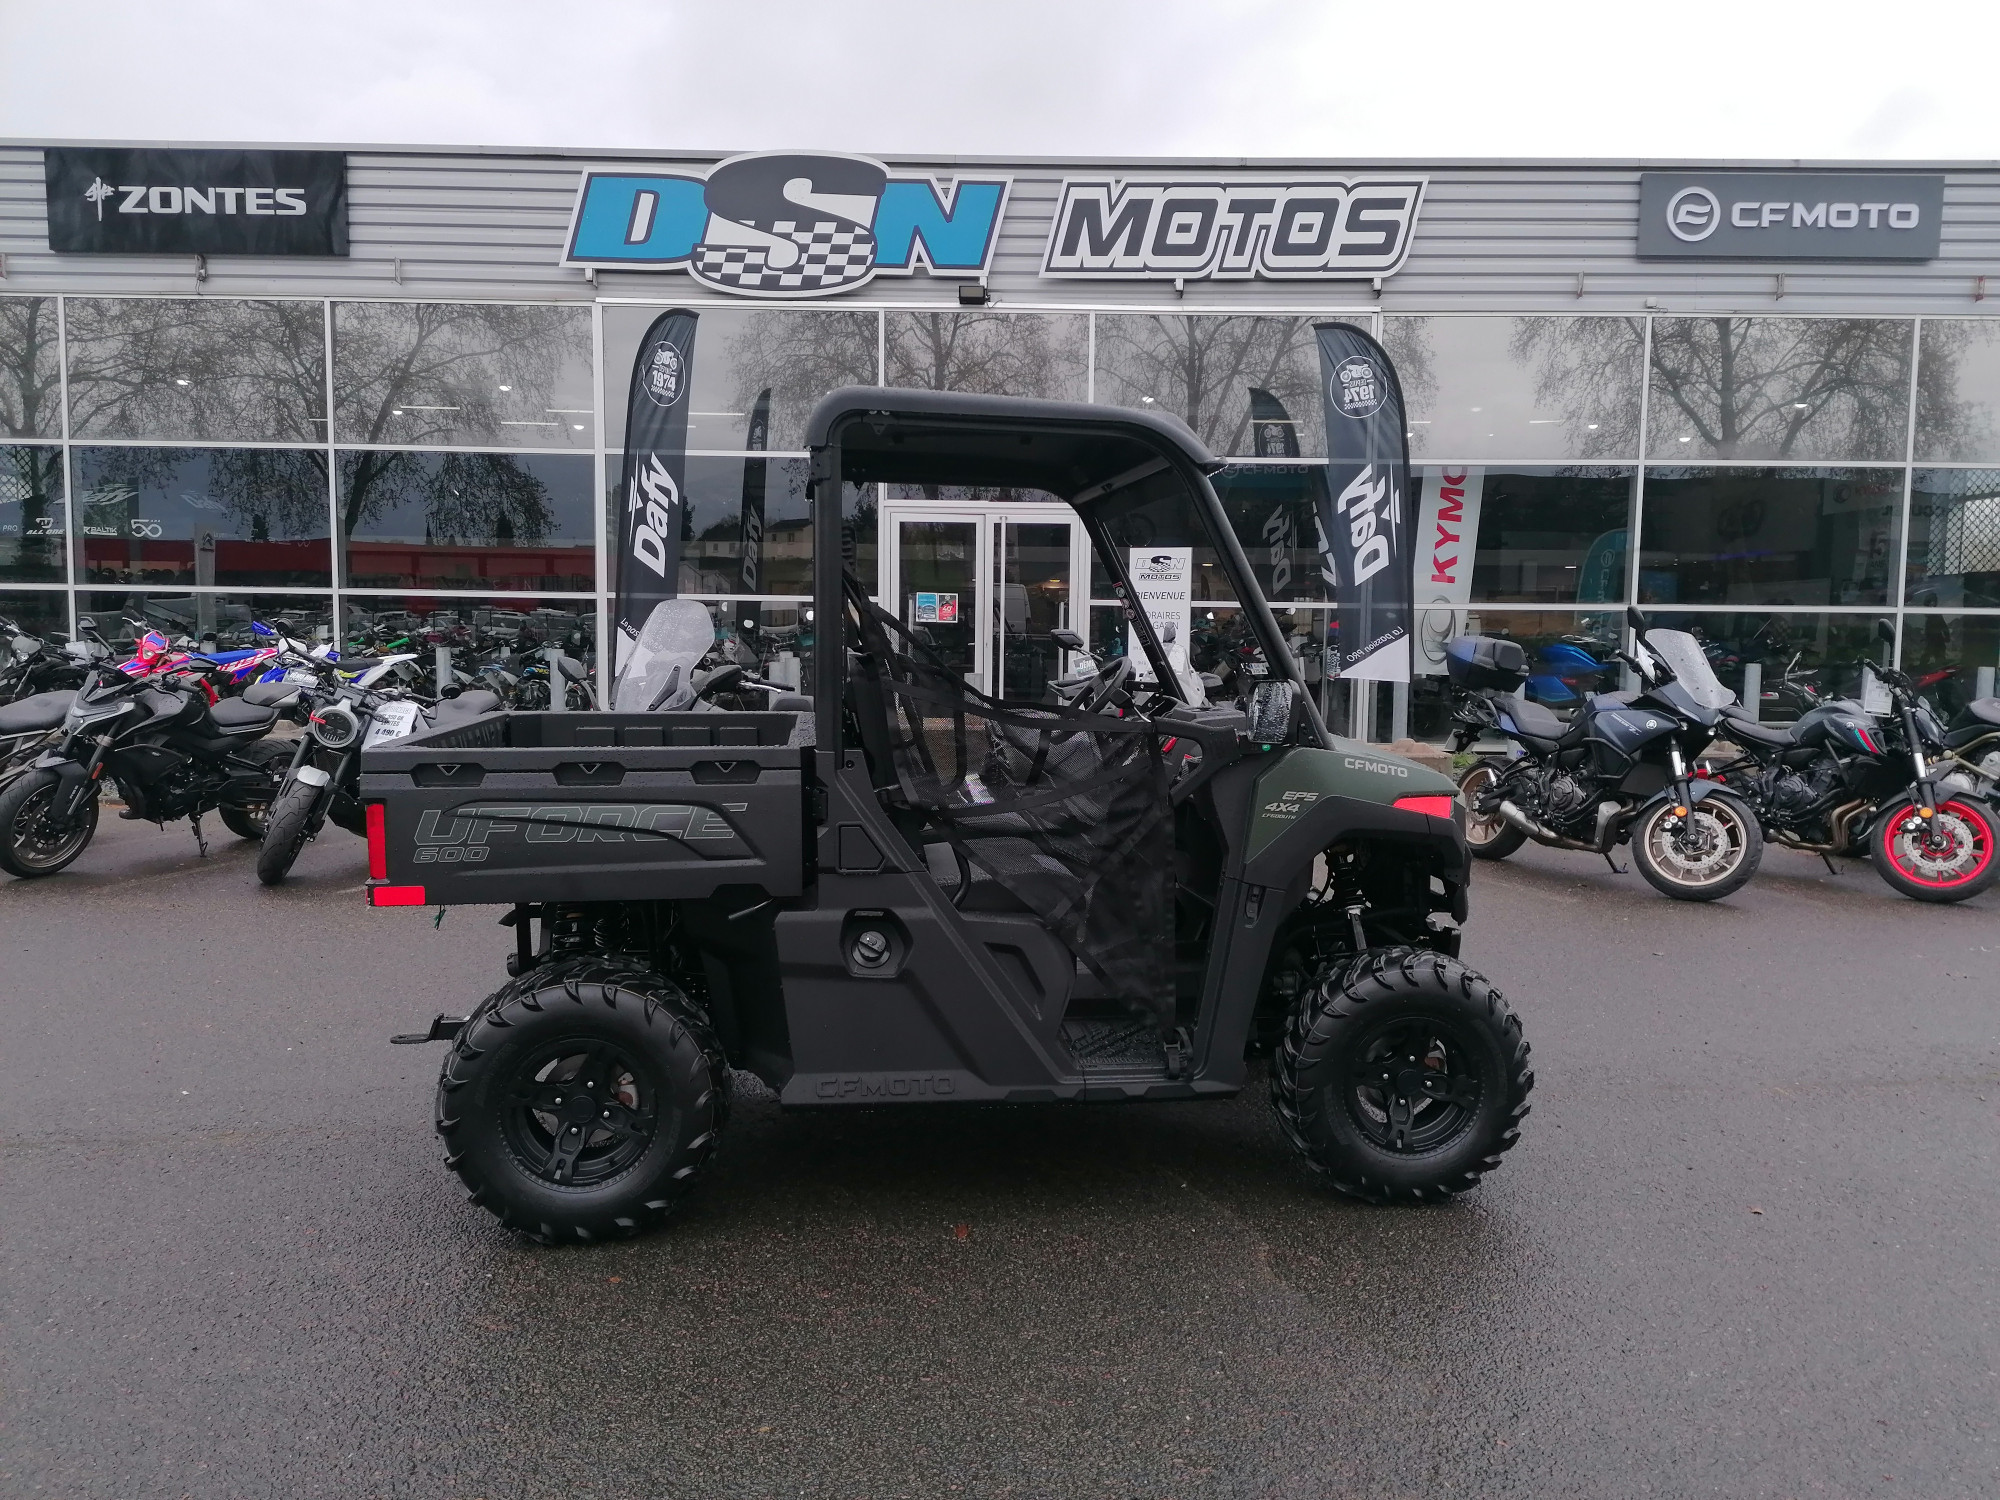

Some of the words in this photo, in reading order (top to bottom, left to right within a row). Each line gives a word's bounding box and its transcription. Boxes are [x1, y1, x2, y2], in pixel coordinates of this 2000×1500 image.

[118, 185, 307, 216] ZONTES
[562, 150, 1012, 297] DSN
[1047, 183, 1424, 271] MOTOS
[1731, 201, 1920, 229] CFMOTO
[652, 369, 676, 391] 1974
[633, 451, 679, 579] Dafy
[1430, 466, 1468, 584] KYMC
[1139, 573, 1182, 581] MOTOS
[1145, 611, 1181, 620] ORAIRES
[1344, 757, 1408, 778] CFMOTO
[1264, 802, 1300, 812] 4X4
[1282, 791, 1319, 801] EPS
[413, 803, 748, 846] UFORCE
[412, 846, 490, 863] 600
[815, 1074, 956, 1099] CFMOTO
